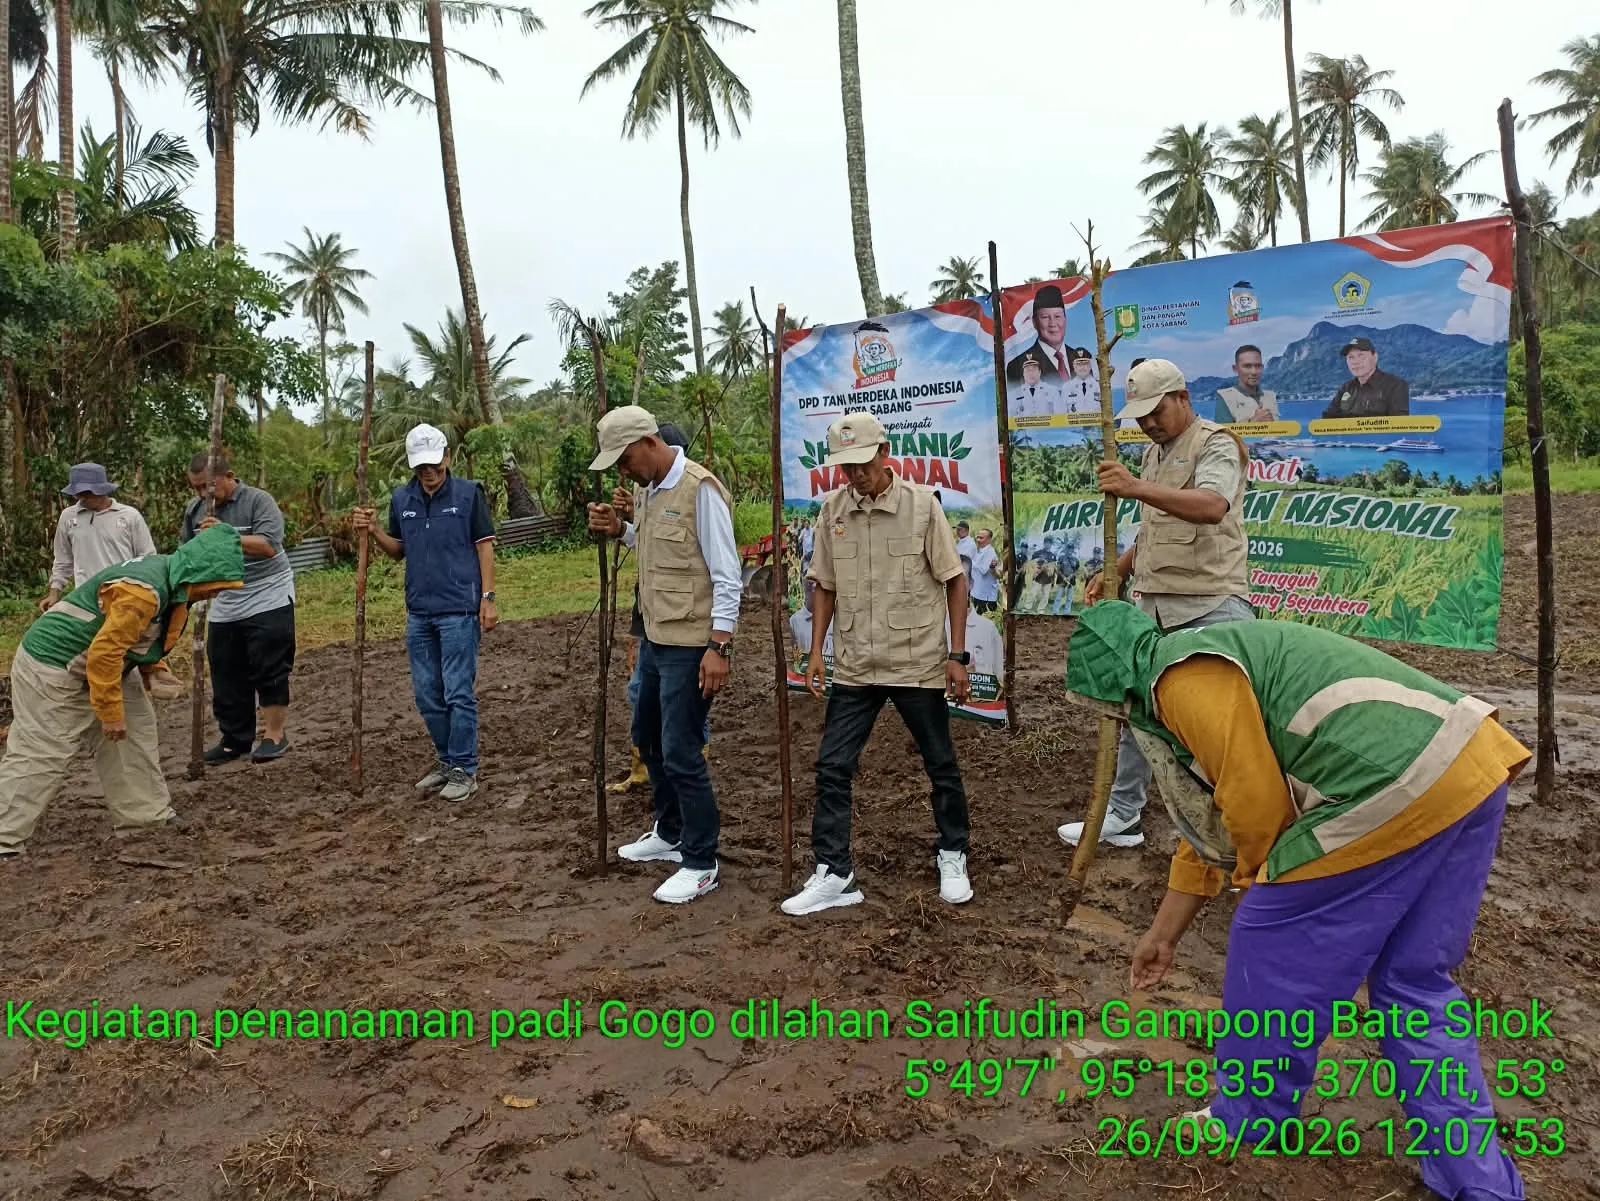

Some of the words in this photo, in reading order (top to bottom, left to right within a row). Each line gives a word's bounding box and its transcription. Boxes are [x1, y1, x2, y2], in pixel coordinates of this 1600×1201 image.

[799, 397, 819, 410] DPD
[823, 395, 847, 408] TANI
[848, 388, 898, 405] MERDEKA
[901, 380, 965, 399] INDONESIA
[870, 401, 912, 415] SABANG
[882, 417, 933, 434] mperingati
[887, 432, 949, 458] TANI
[809, 457, 969, 498] NANAL
[1284, 491, 1458, 539] NASIONAL
[1249, 540, 1284, 557] 2026
[1250, 569, 1319, 591] Tangguh
[1286, 593, 1370, 616] Sejahtera
